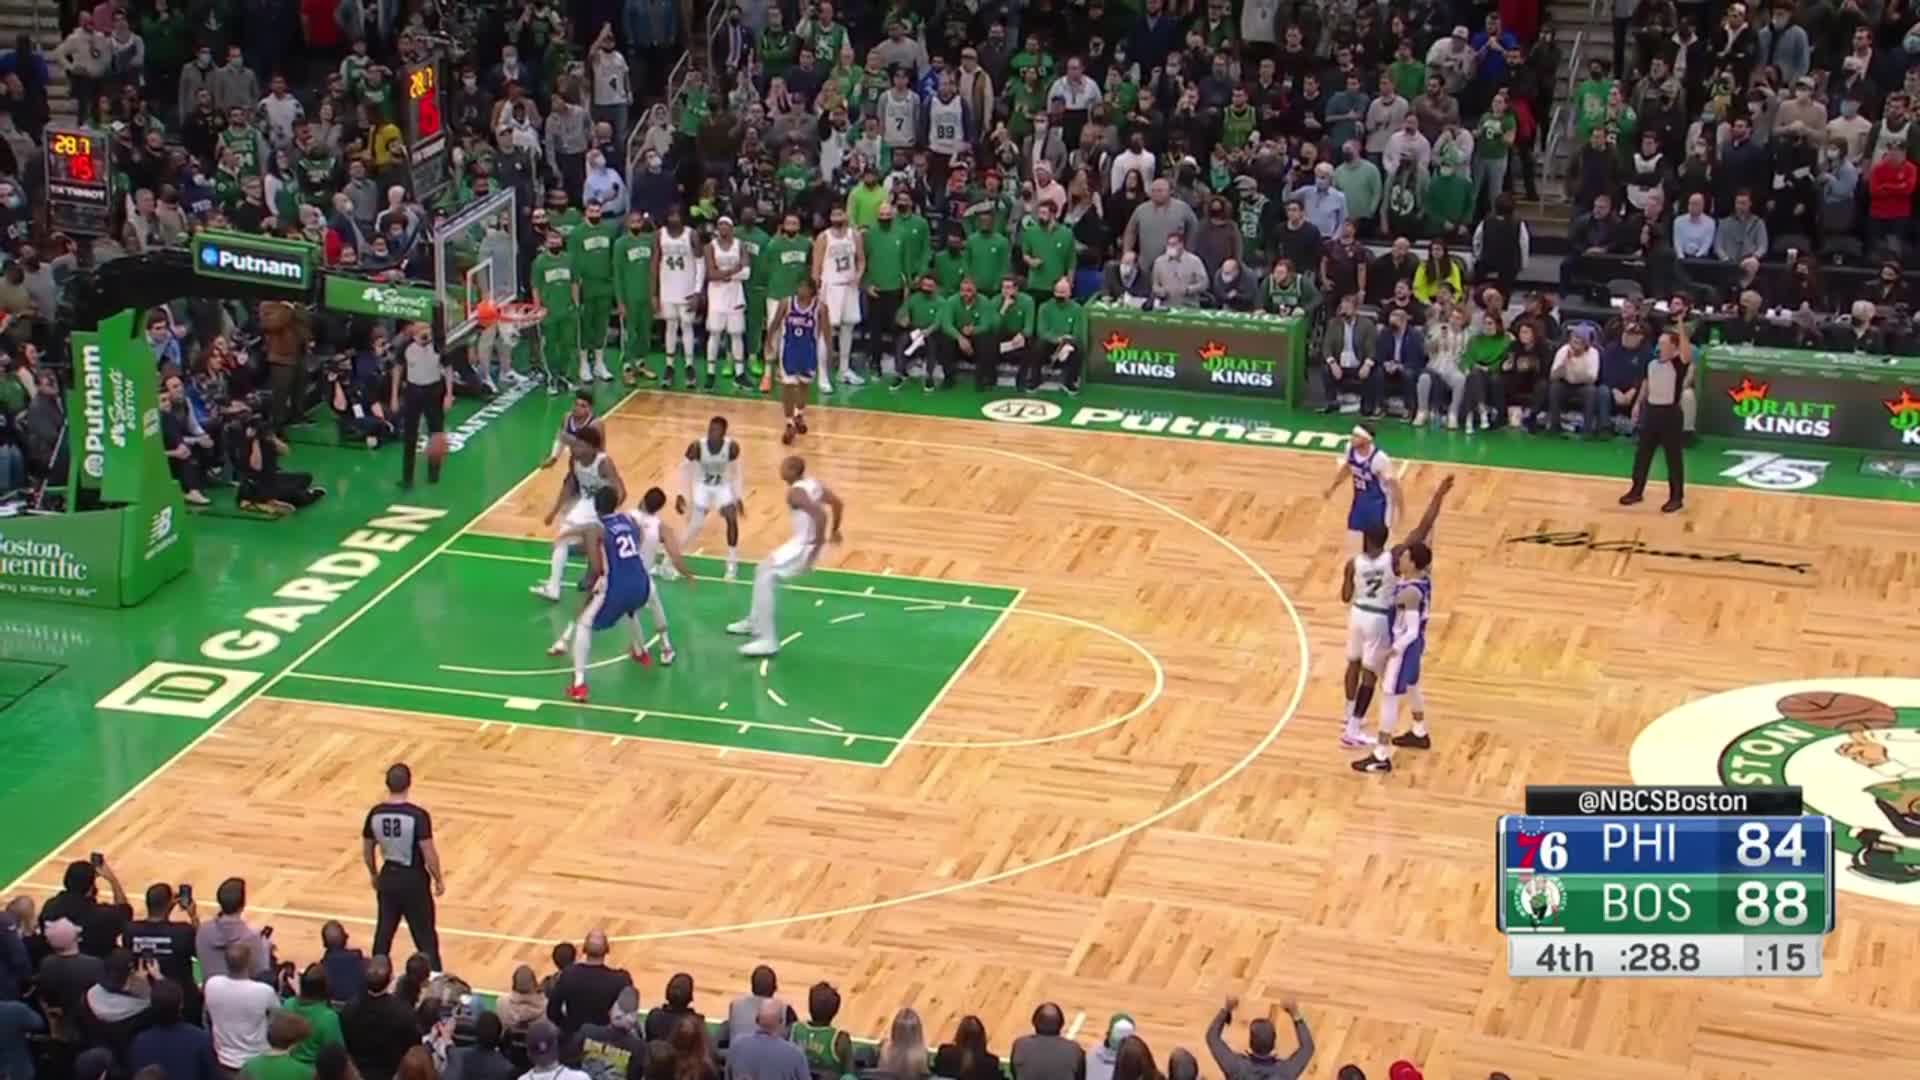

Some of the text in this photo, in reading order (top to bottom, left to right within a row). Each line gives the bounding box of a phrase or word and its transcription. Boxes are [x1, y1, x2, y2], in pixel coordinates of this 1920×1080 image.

[218, 250, 302, 279] Putnam
[666, 255, 685, 270] 44
[835, 255, 850, 272] 13
[1106, 347, 1180, 365] DRAFT
[1203, 356, 1277, 374] DRAFT
[1115, 360, 1177, 379] KINGS
[1211, 368, 1274, 387] KINGS
[83, 345, 105, 453] Putnam
[1733, 398, 1836, 419] DRAFT
[1071, 405, 1352, 448] Putnam
[1744, 414, 1831, 438] KINGS
[0, 534, 61, 558] oston
[615, 532, 639, 559] 21
[0, 551, 87, 580] ientific
[200, 503, 450, 661] GARDEN
[1730, 723, 1817, 785] STON
